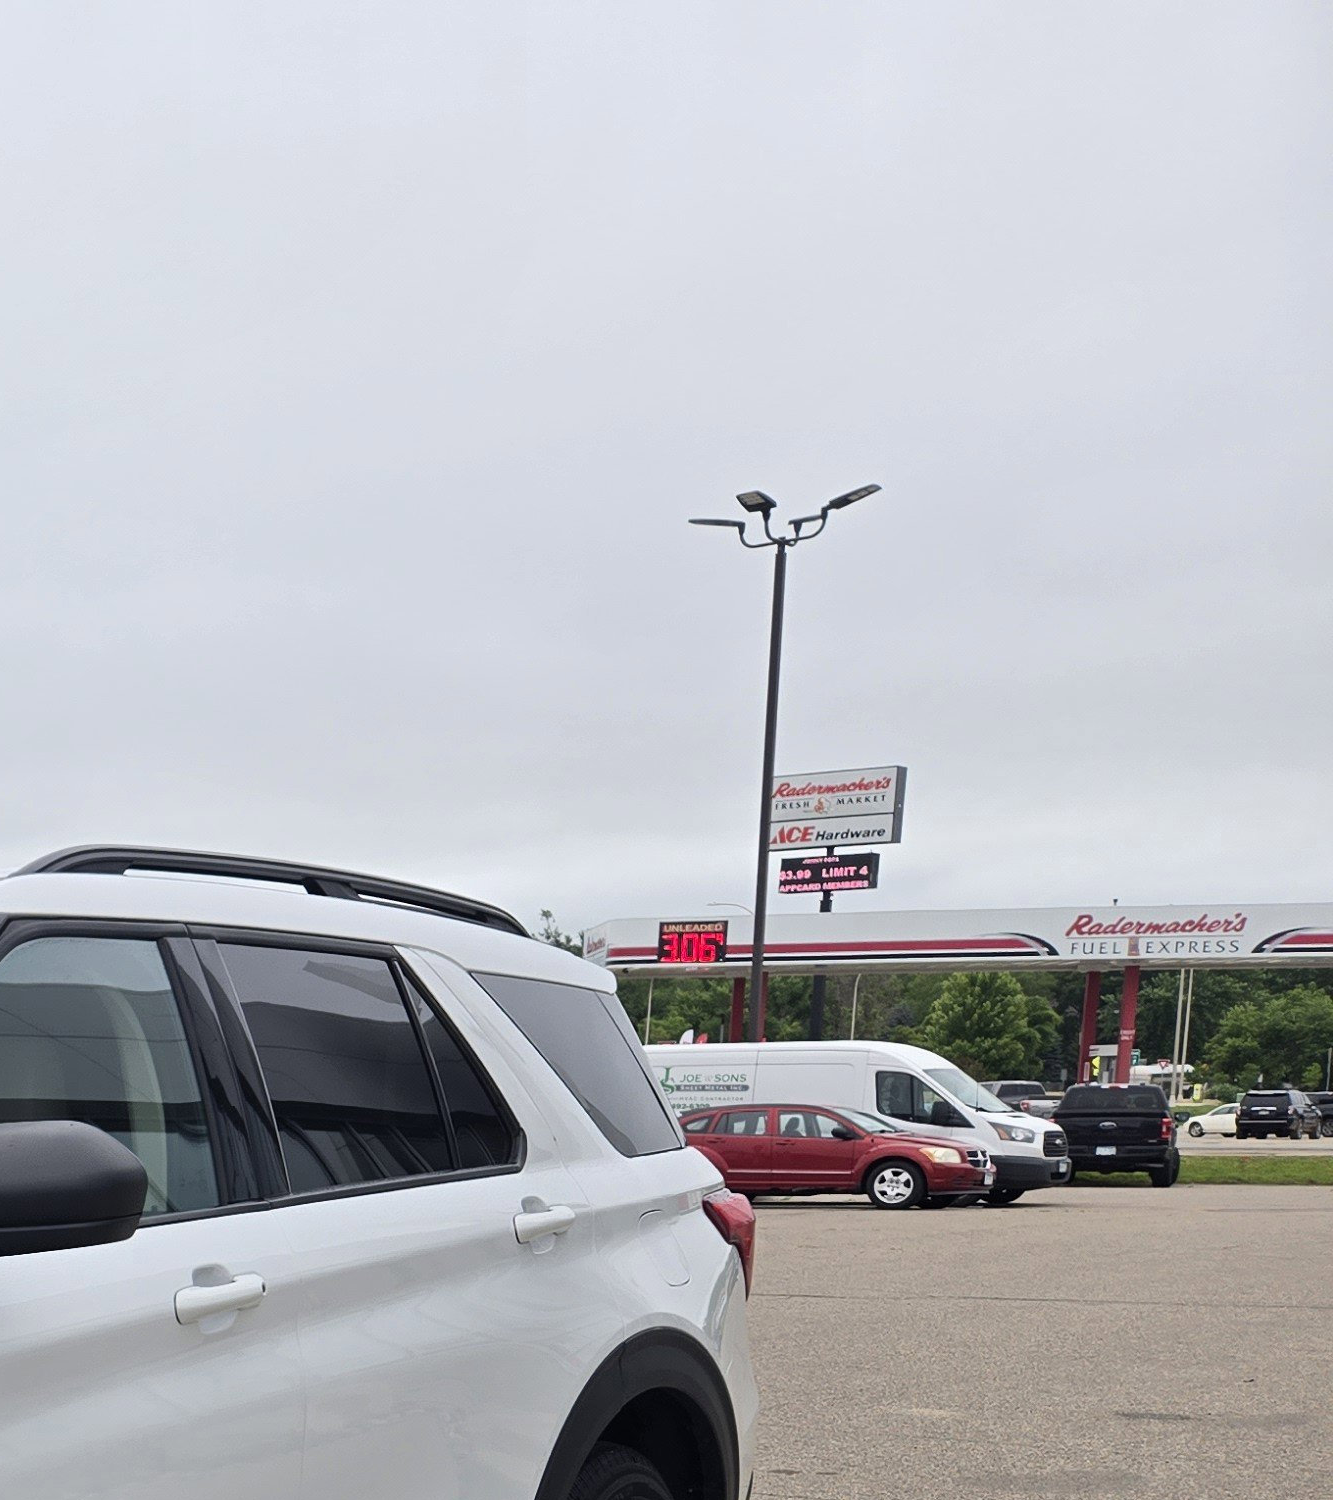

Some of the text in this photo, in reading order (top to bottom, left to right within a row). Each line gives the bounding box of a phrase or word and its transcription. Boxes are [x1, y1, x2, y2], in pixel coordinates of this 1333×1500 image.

[772, 777, 891, 799] Radermacher's
[775, 795, 886, 810] FRESH MARKET
[770, 826, 886, 844] ACE Hardware
[821, 866, 857, 878] LIMIT
[859, 865, 868, 875] 4
[663, 923, 723, 932] UNLEADED
[1065, 913, 1248, 937] Radermacher's
[1070, 940, 1240, 954] FUEL EXPRESS
[680, 1074, 702, 1082] JOE
[714, 1074, 747, 1082] SONS
